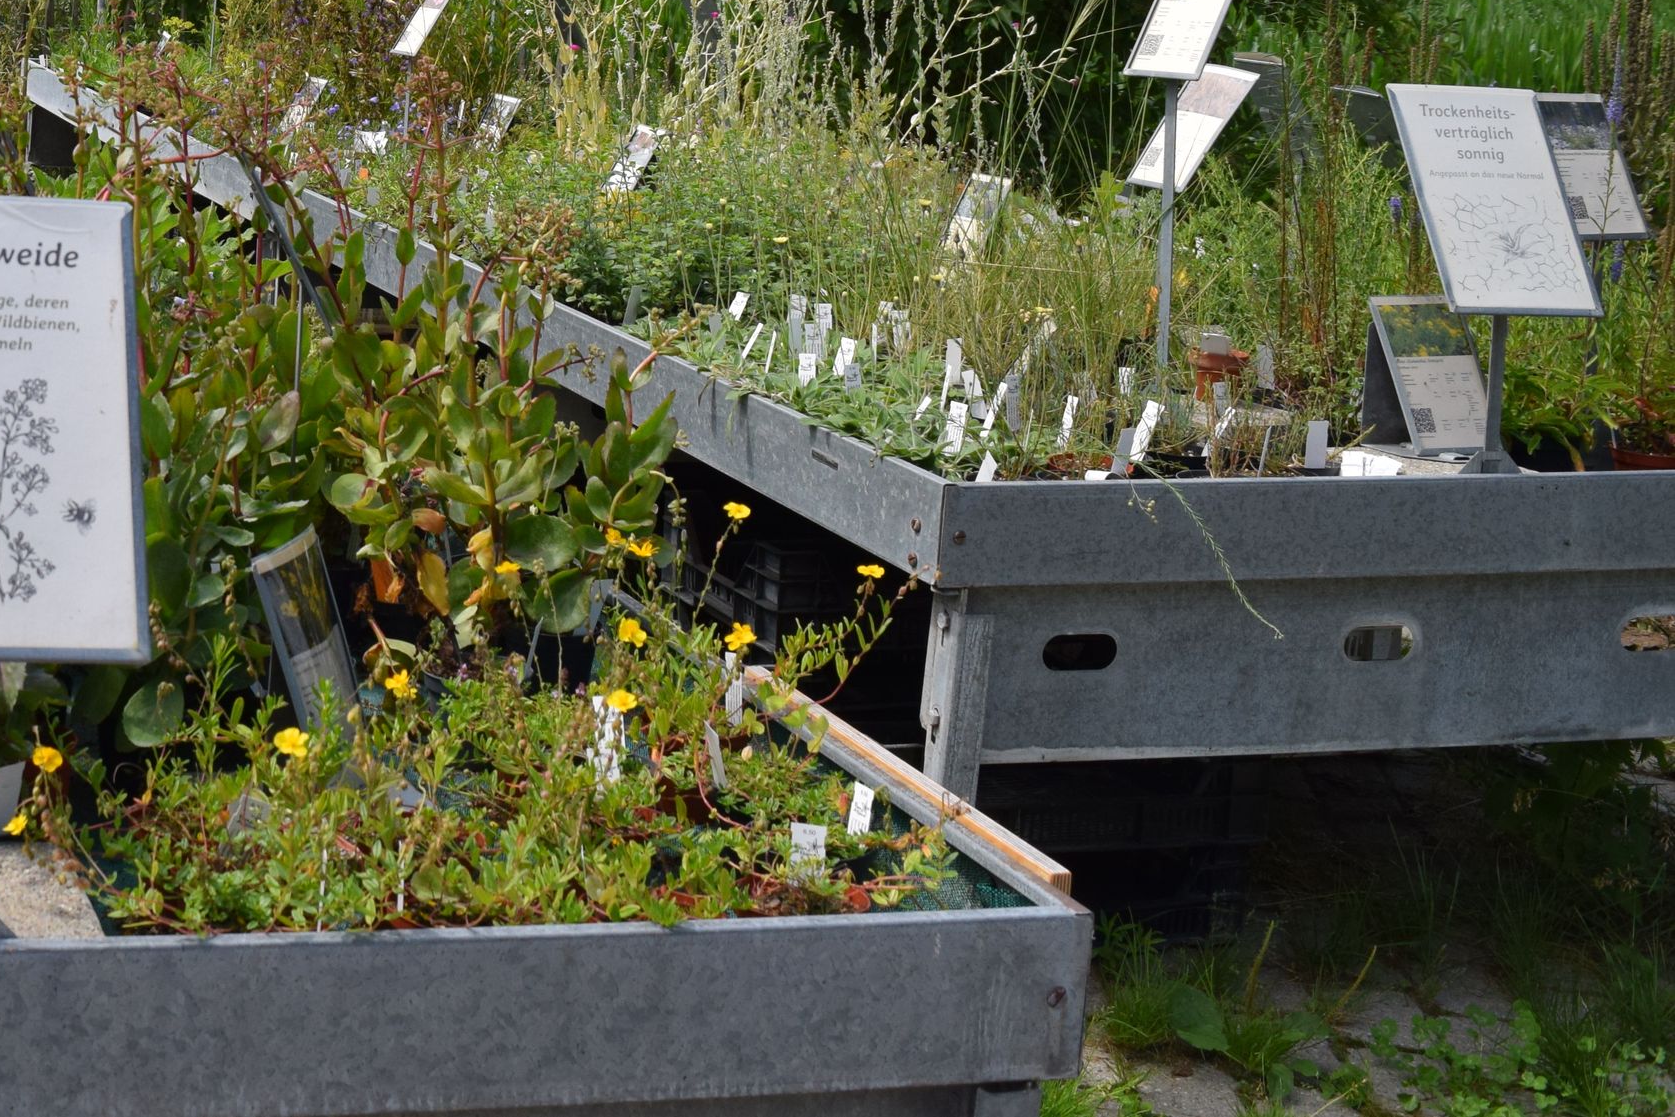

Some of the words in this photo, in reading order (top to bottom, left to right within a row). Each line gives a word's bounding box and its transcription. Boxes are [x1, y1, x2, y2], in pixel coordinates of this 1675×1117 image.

[1419, 103, 1516, 120] Trockenheits-
[1435, 125, 1514, 142] verträglich
[1457, 147, 1505, 164] sonnig
[1429, 169, 1468, 179] Angepasst
[1516, 171, 1544, 180] Normal
[25, 294, 70, 309] deren
